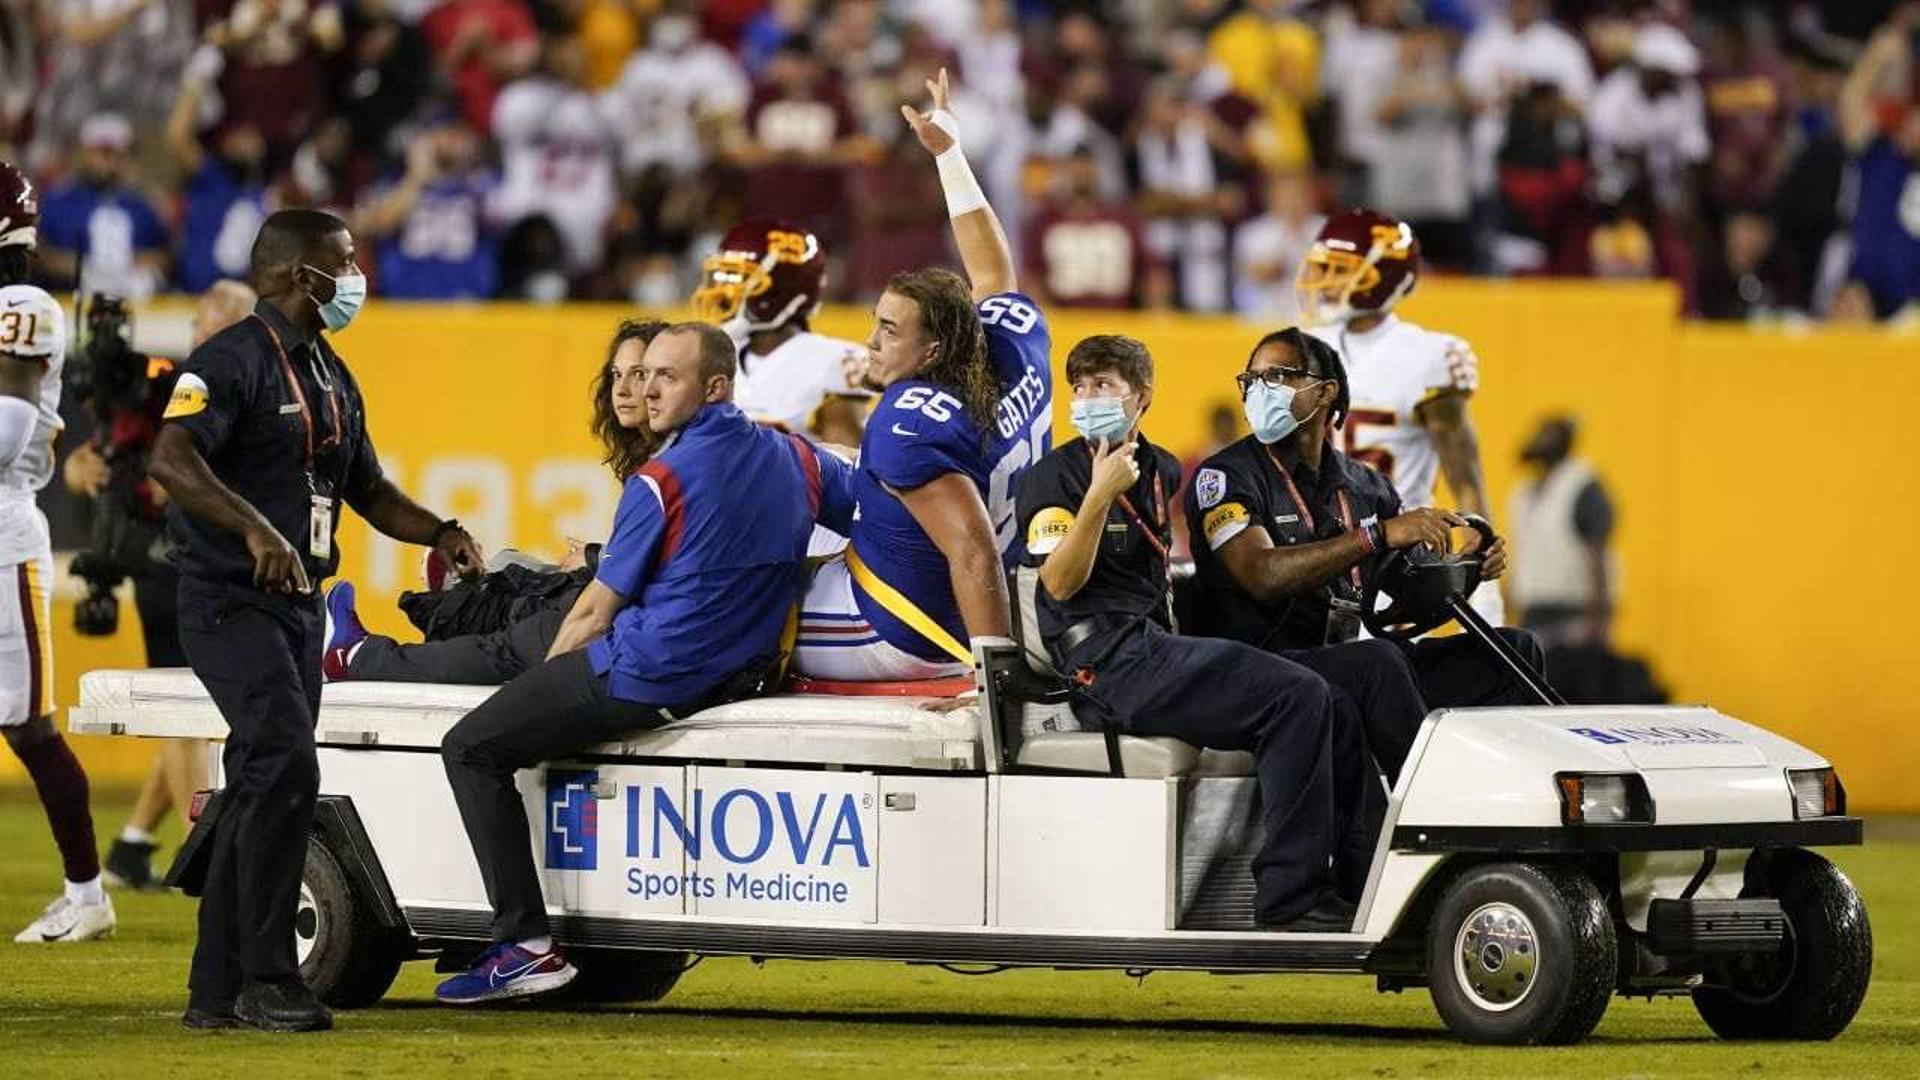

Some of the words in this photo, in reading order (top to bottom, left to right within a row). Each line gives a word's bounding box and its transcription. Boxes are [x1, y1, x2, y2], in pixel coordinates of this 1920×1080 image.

[1, 311, 36, 346] 31
[894, 387, 963, 423] 65
[998, 365, 1044, 439] GATES
[626, 785, 870, 868] INOVA
[626, 867, 715, 900] Sports
[726, 871, 848, 903] Medicine
